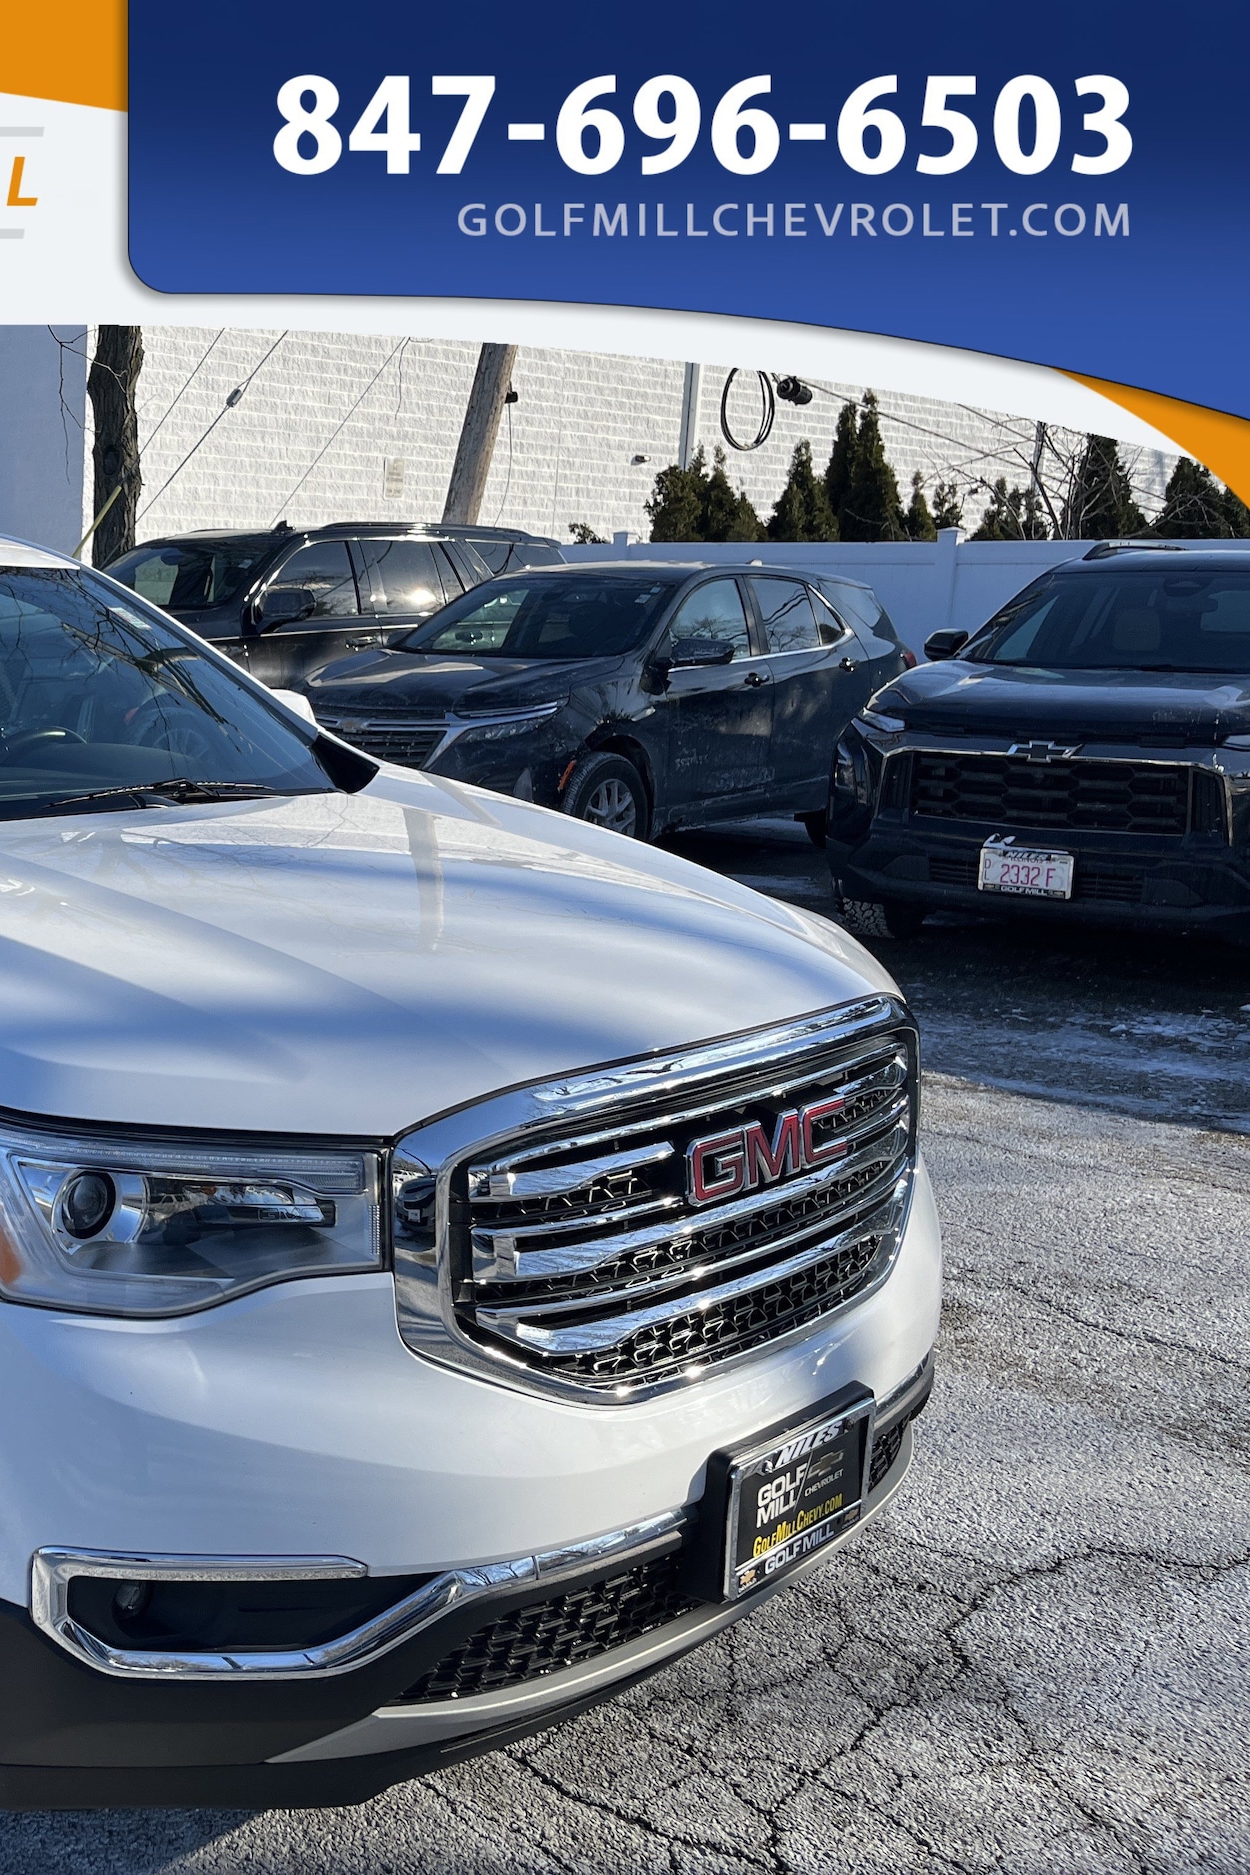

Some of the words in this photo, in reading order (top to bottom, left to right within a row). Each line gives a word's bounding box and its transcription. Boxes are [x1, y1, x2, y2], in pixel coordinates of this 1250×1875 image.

[999, 863, 1041, 887] 2332
[1045, 867, 1056, 888] F
[1000, 885, 1024, 895] GOLF
[1024, 887, 1048, 896] MILL
[687, 1099, 848, 1206] GMC
[775, 1421, 843, 1469] NILES
[757, 1462, 808, 1507] GOLF
[804, 1468, 844, 1497] CHEVROLET
[756, 1489, 797, 1528] MILL
[764, 1541, 802, 1575] GOLF
[802, 1523, 835, 1553] MILL
